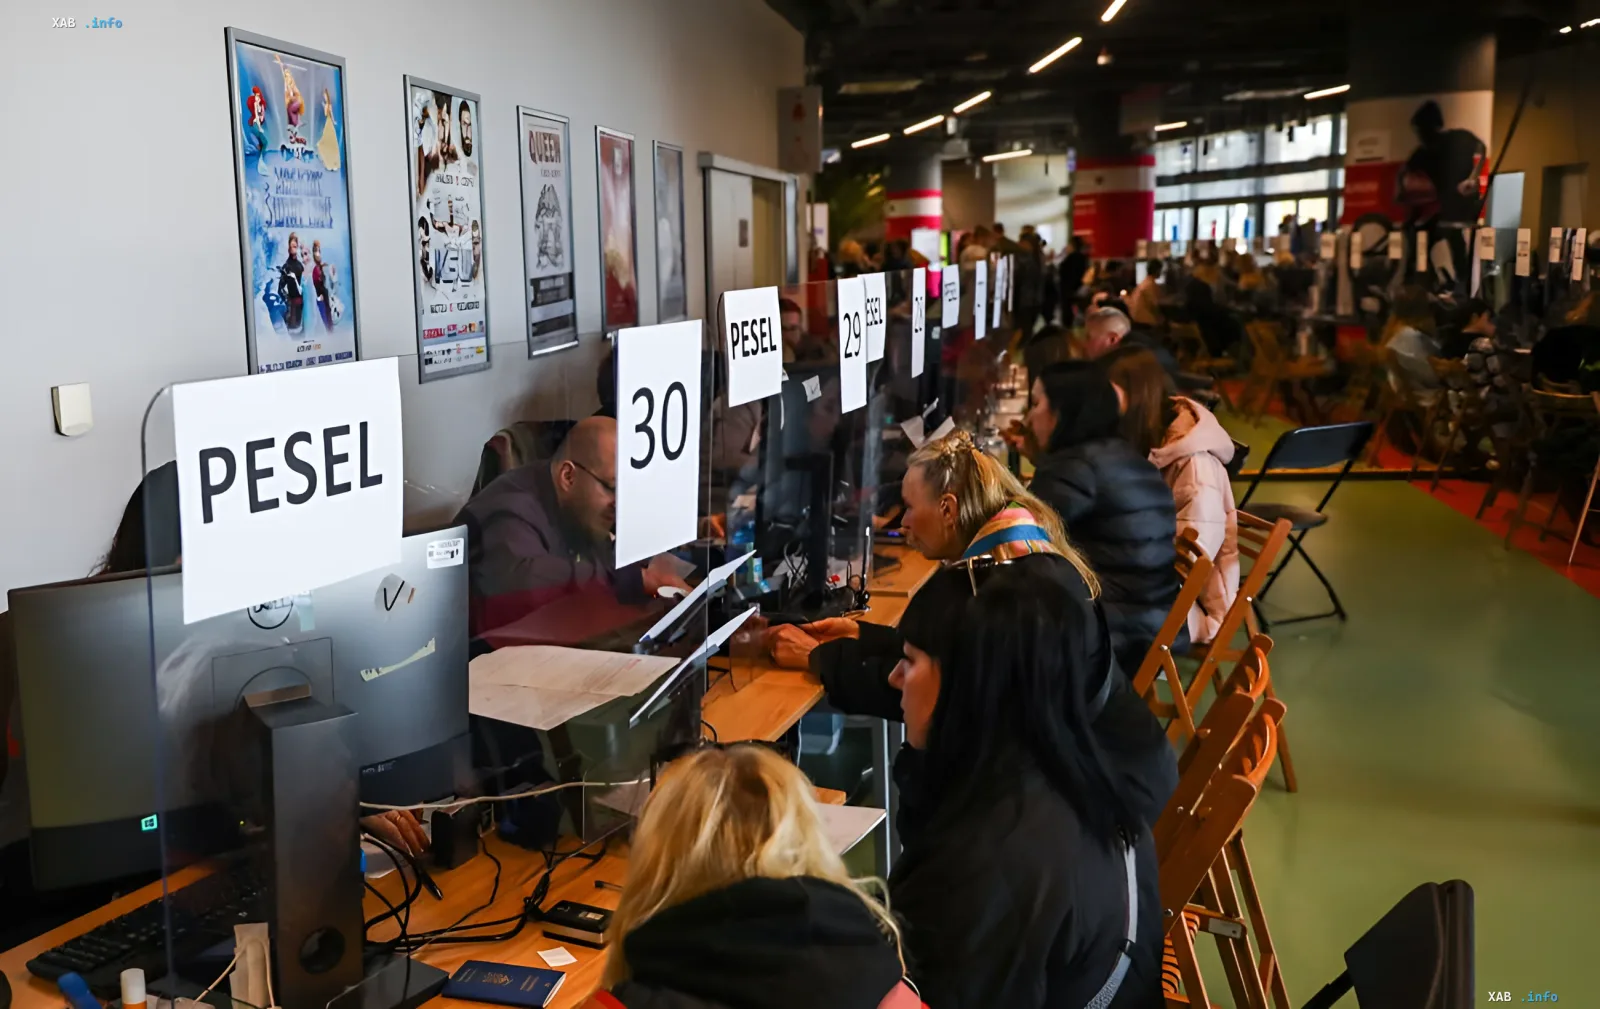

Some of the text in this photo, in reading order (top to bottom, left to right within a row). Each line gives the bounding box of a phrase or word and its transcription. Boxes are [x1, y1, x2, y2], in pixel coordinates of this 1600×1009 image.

[730, 316, 777, 360] PESEL
[843, 311, 862, 359] 29
[630, 381, 688, 470] 30
[199, 421, 383, 524] PESEL
